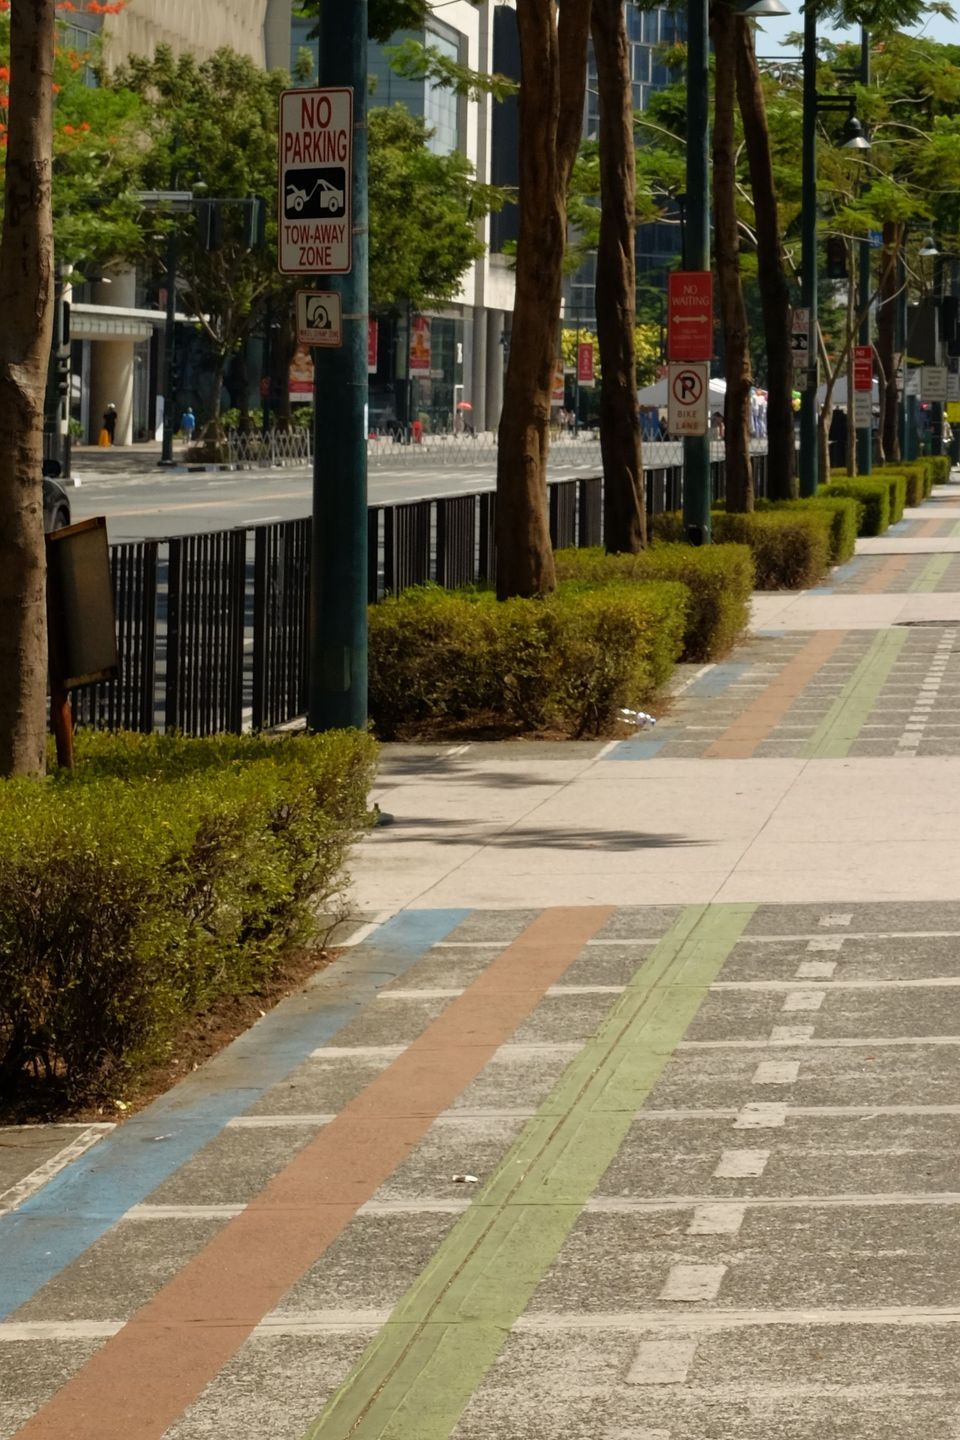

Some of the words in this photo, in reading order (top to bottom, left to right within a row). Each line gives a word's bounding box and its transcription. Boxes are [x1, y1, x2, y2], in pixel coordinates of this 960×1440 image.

[301, 96, 332, 129] NO
[284, 129, 347, 164] PARKING
[284, 224, 346, 245] TOW-AWAY
[299, 246, 332, 266] ZONE
[683, 285, 698, 295] NO
[672, 296, 710, 306] WAITING
[677, 410, 698, 419] BIKE
[676, 421, 699, 430] LANE
